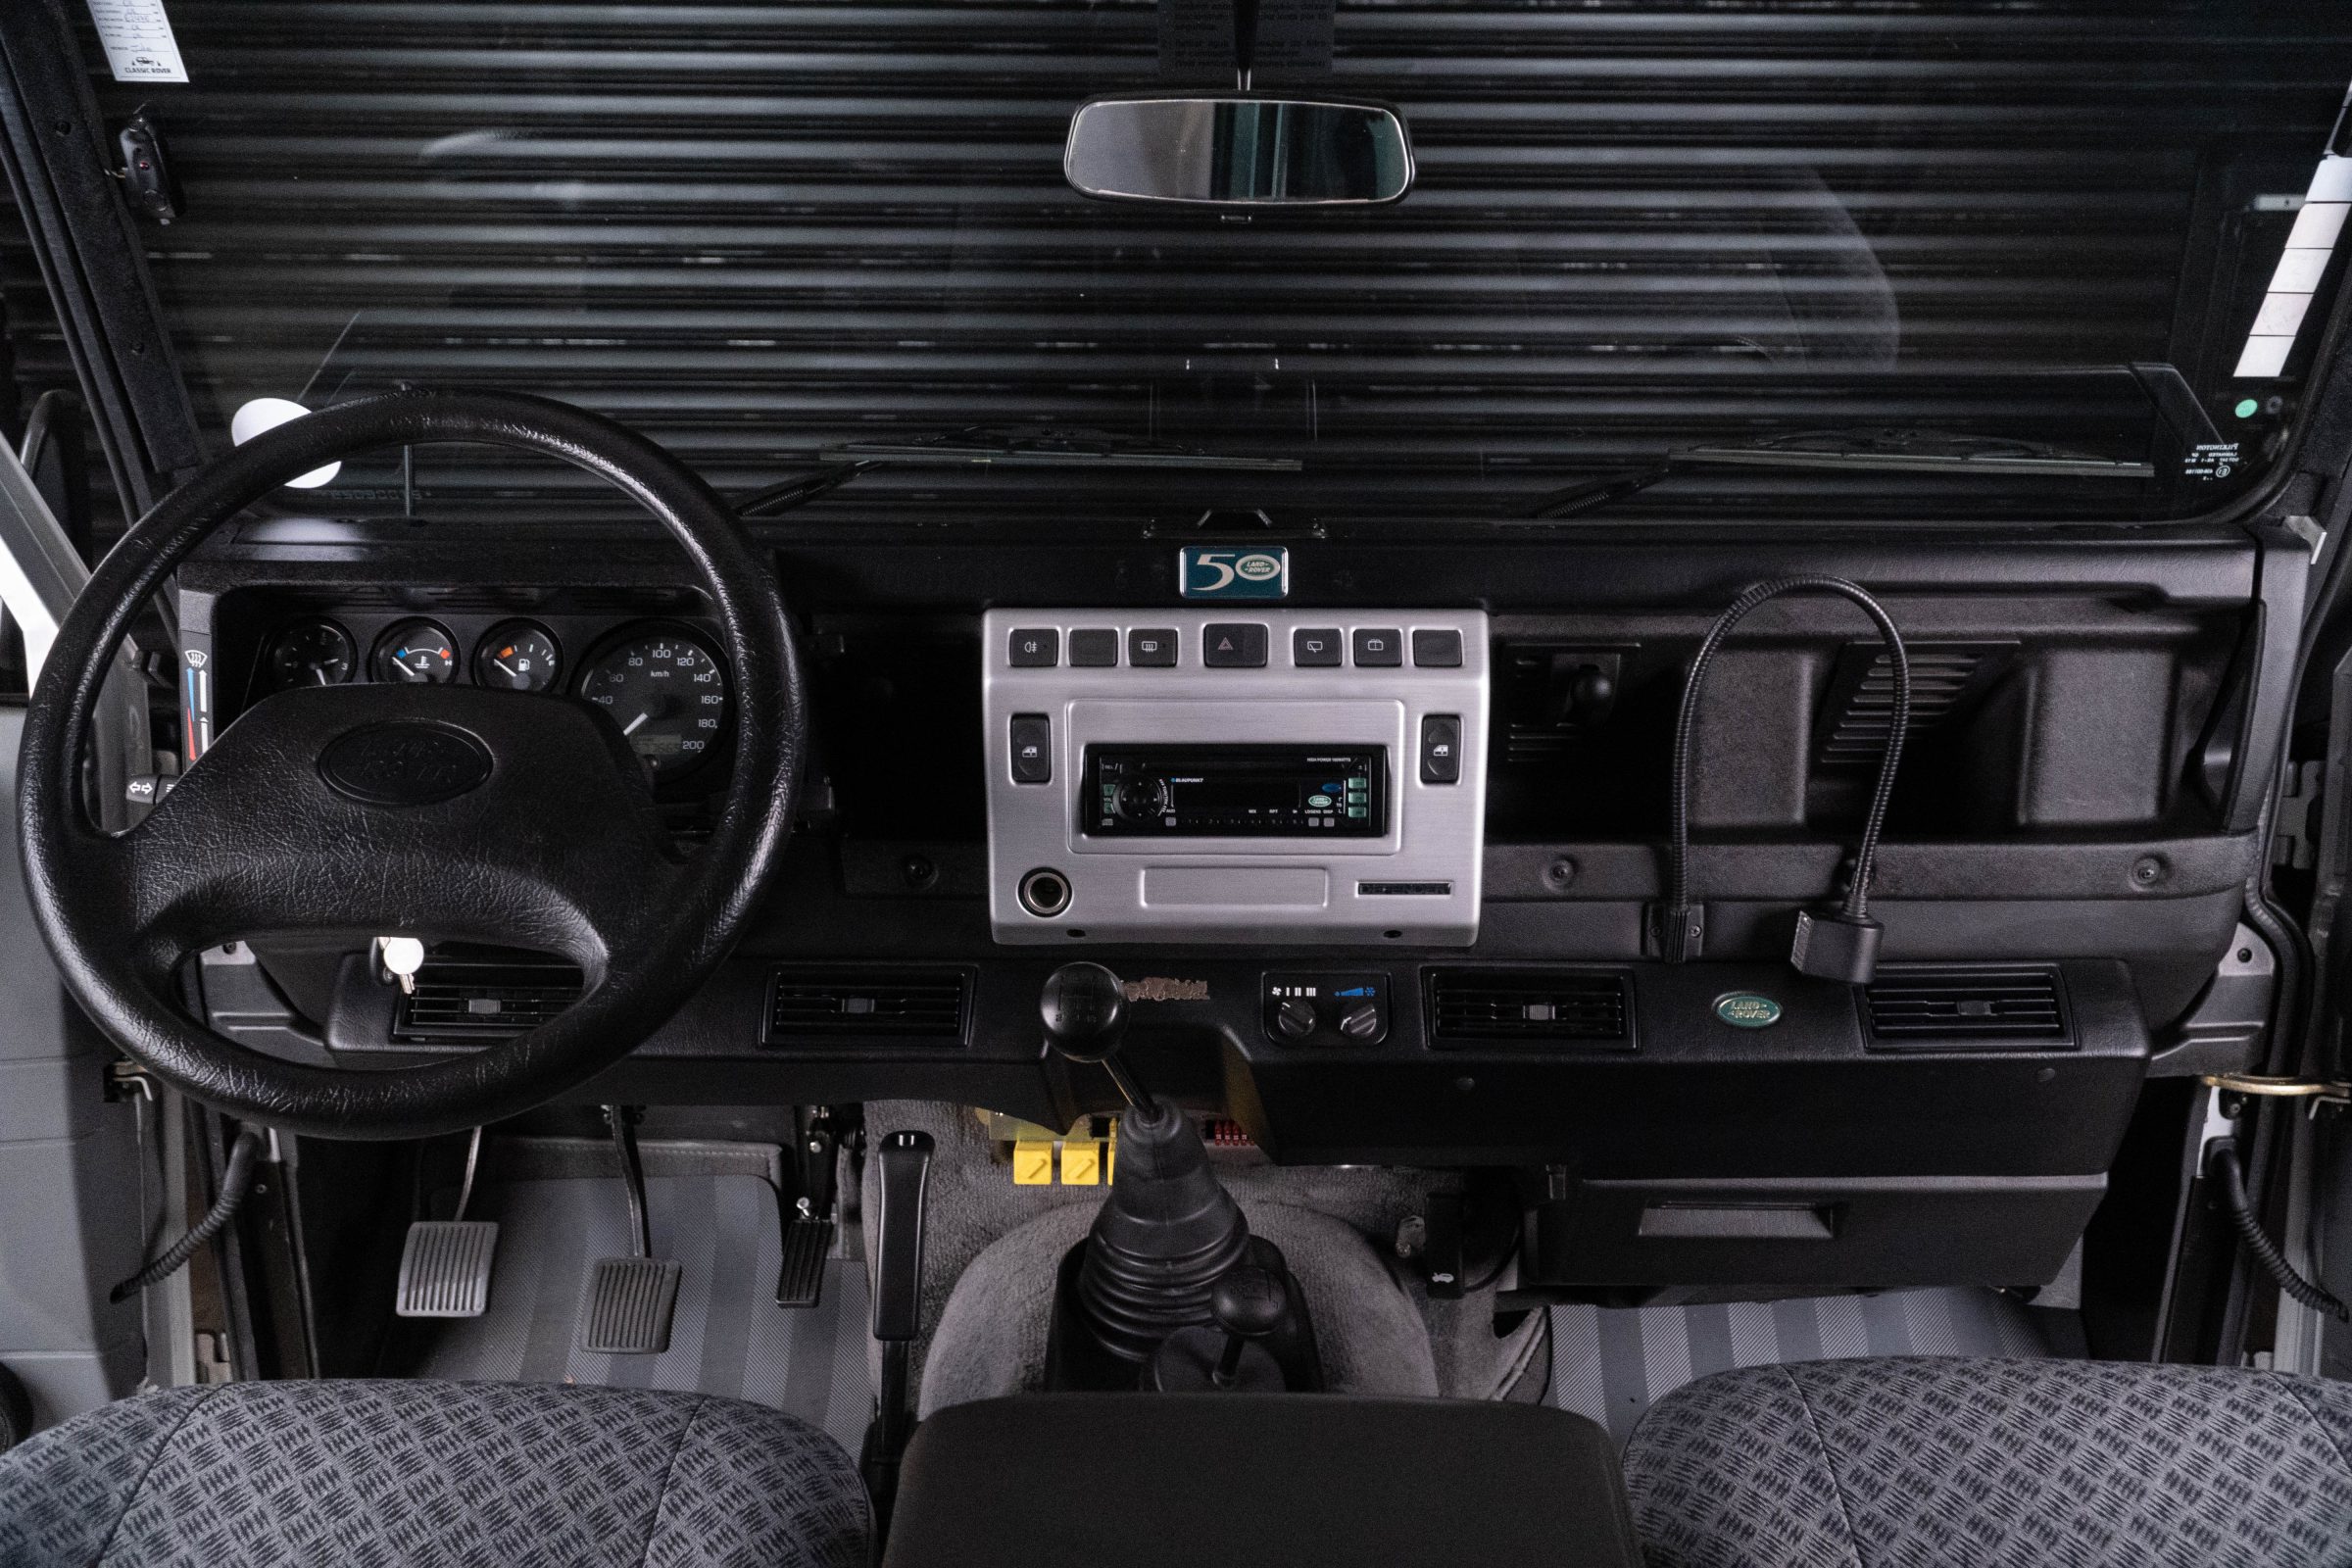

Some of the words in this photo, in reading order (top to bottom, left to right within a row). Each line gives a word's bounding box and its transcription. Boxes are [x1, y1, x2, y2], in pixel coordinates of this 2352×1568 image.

[653, 650, 671, 659] 100
[628, 658, 643, 666] 80
[677, 658, 695, 666] 120
[698, 719, 715, 728] 180
[682, 741, 705, 750] 200
